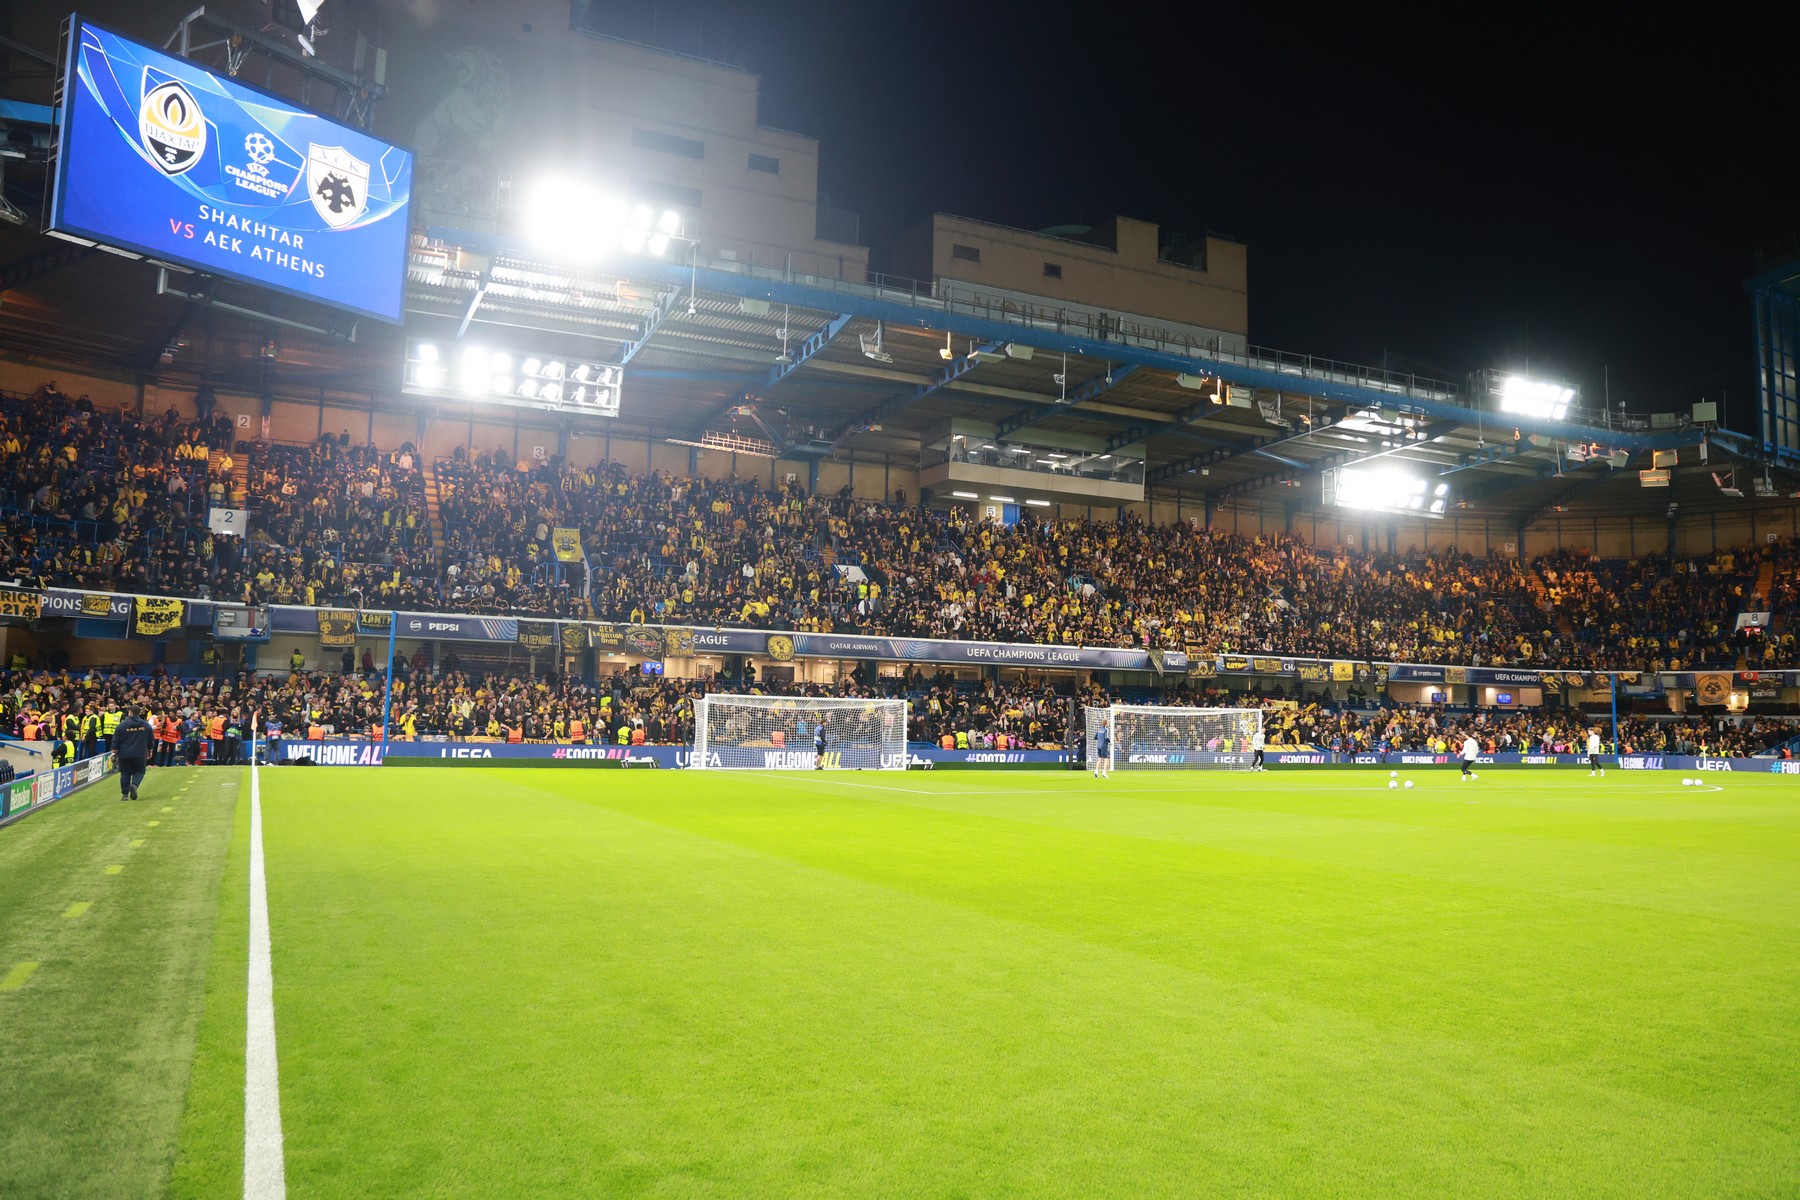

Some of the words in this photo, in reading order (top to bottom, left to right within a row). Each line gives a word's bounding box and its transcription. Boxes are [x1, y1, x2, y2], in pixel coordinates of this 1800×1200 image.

[145, 122, 200, 150] ШАХТАР
[224, 165, 288, 193] CHAMPIONS
[236, 178, 278, 198] LEAGUE
[199, 204, 304, 250] SHAKHTAR
[170, 218, 195, 240] VS
[204, 231, 242, 254] AEK
[250, 244, 326, 278] ATHENS
[240, 417, 248, 427] 2
[536, 448, 542, 457] 3
[224, 511, 233, 522] 2
[0, 591, 38, 605] RICH
[3, 604, 19, 615] 21
[429, 623, 459, 631] PEPSI
[967, 648, 990, 658] UEFA
[993, 650, 1045, 660] CHAMPIONS
[1048, 652, 1080, 661] LEAGUE
[287, 745, 358, 764] WELCOME
[676, 752, 722, 766] UEFA
[765, 752, 818, 768] WELCOME
[820, 752, 842, 768] ALL
[1618, 757, 1644, 769] WELCOME
[1645, 758, 1663, 769] ALL
[1696, 760, 1732, 771] UEFA
[1771, 762, 1800, 774] #FOO
